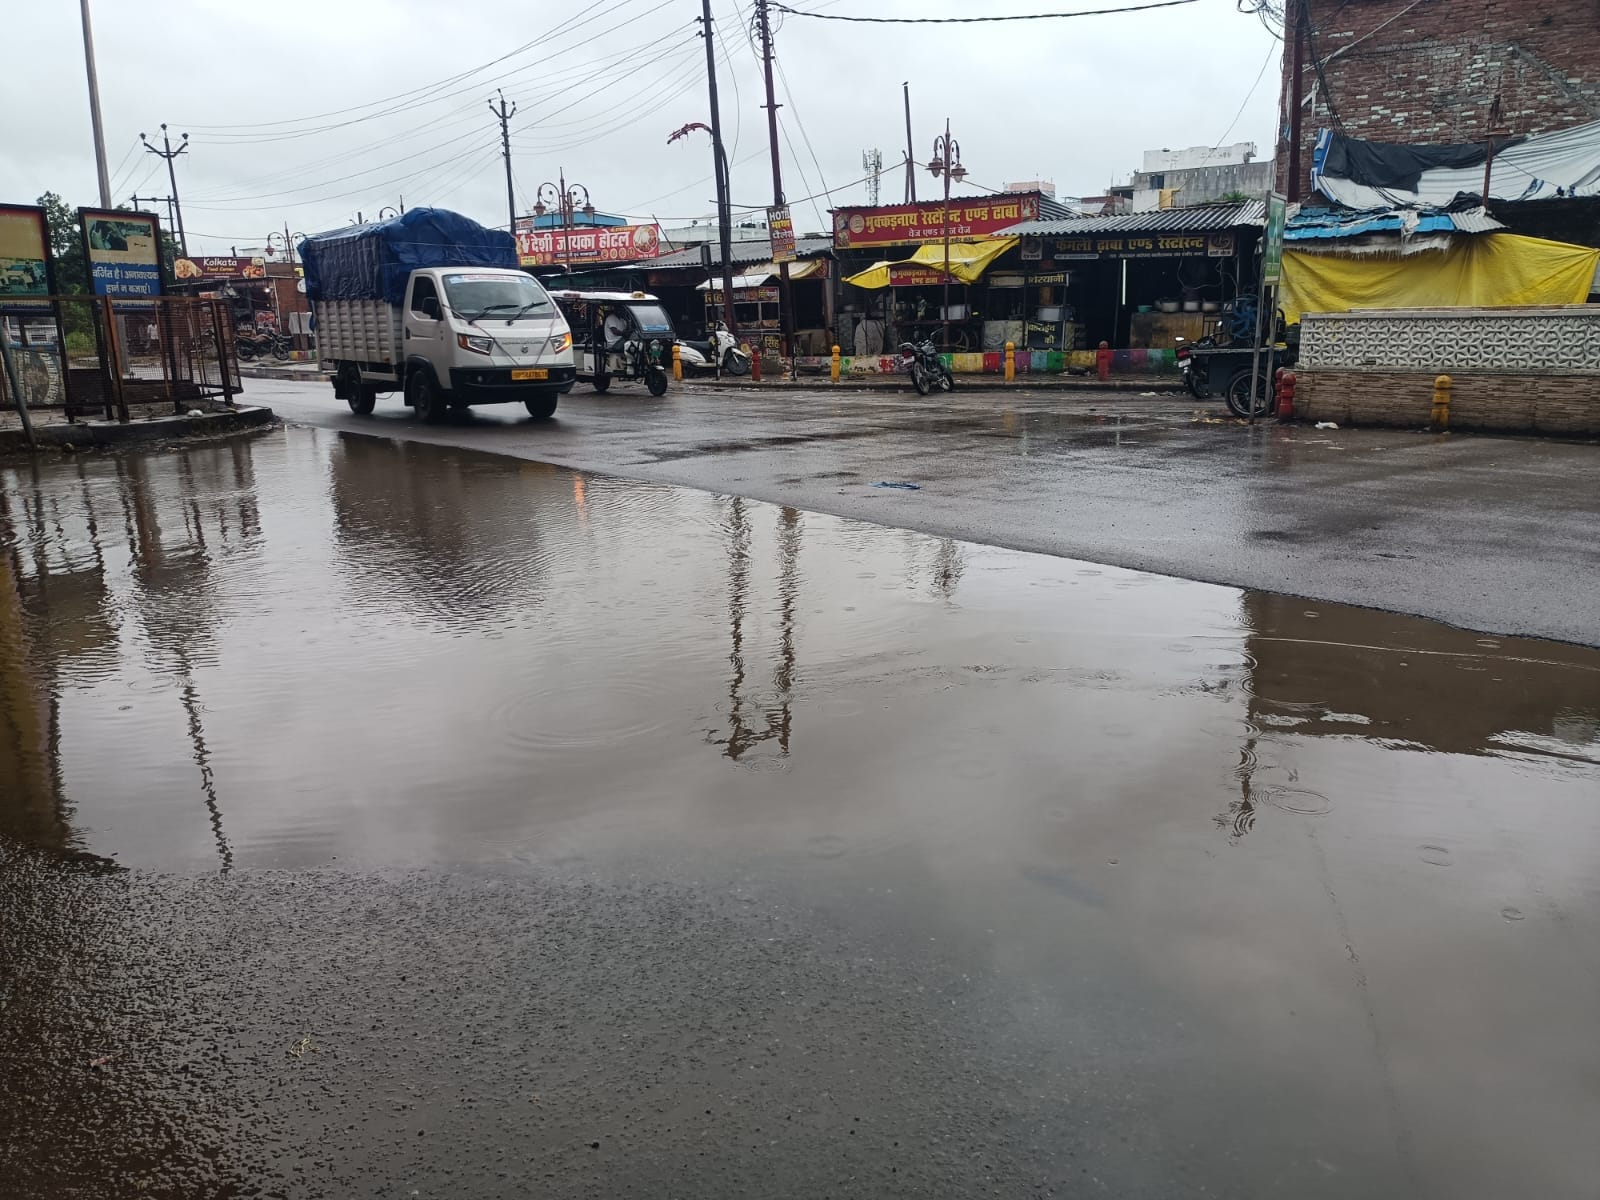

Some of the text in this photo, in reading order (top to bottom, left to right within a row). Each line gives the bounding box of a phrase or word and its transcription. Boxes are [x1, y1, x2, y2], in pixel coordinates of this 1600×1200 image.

[964, 207, 989, 221] एण्ड
[908, 226, 920, 237] वेज
[958, 224, 971, 233] वेज
[530, 233, 553, 253] देशी
[598, 228, 630, 249] होटल
[203, 257, 237, 266] Kolkata
